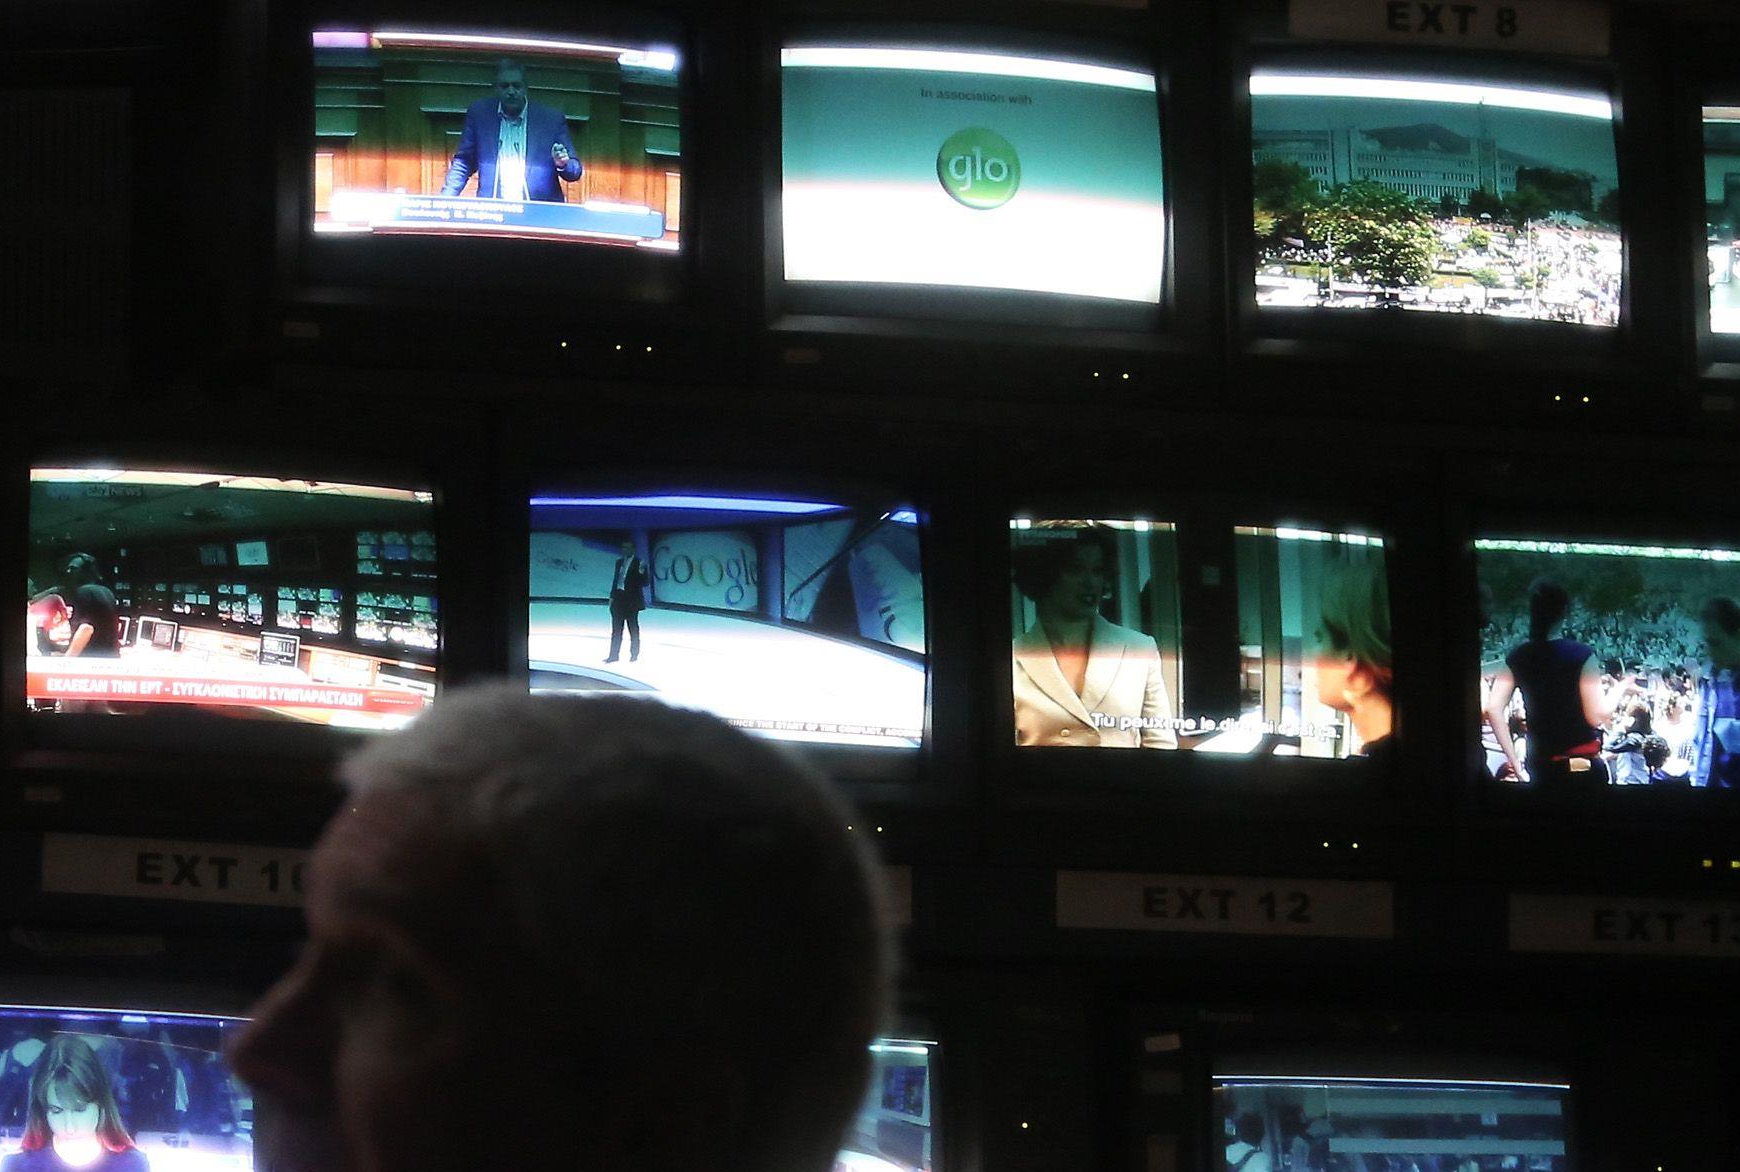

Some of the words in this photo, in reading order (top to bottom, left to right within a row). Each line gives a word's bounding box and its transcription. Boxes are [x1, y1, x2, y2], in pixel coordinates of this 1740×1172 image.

[1386, 1, 1478, 35] EXT
[1495, 6, 1518, 39] 8
[920, 88, 933, 98] In
[936, 90, 1005, 103] association
[1007, 94, 1033, 106] with
[948, 146, 1009, 192] glo
[1091, 712, 1116, 729] Tu
[1119, 715, 1167, 731] peux
[1168, 717, 1196, 730] me
[1199, 715, 1216, 731] le
[1219, 716, 1253, 733] dir
[135, 852, 239, 889] EXT
[1142, 886, 1237, 920] EXT
[1258, 891, 1313, 924] 12
[1593, 909, 1684, 942] EXT
